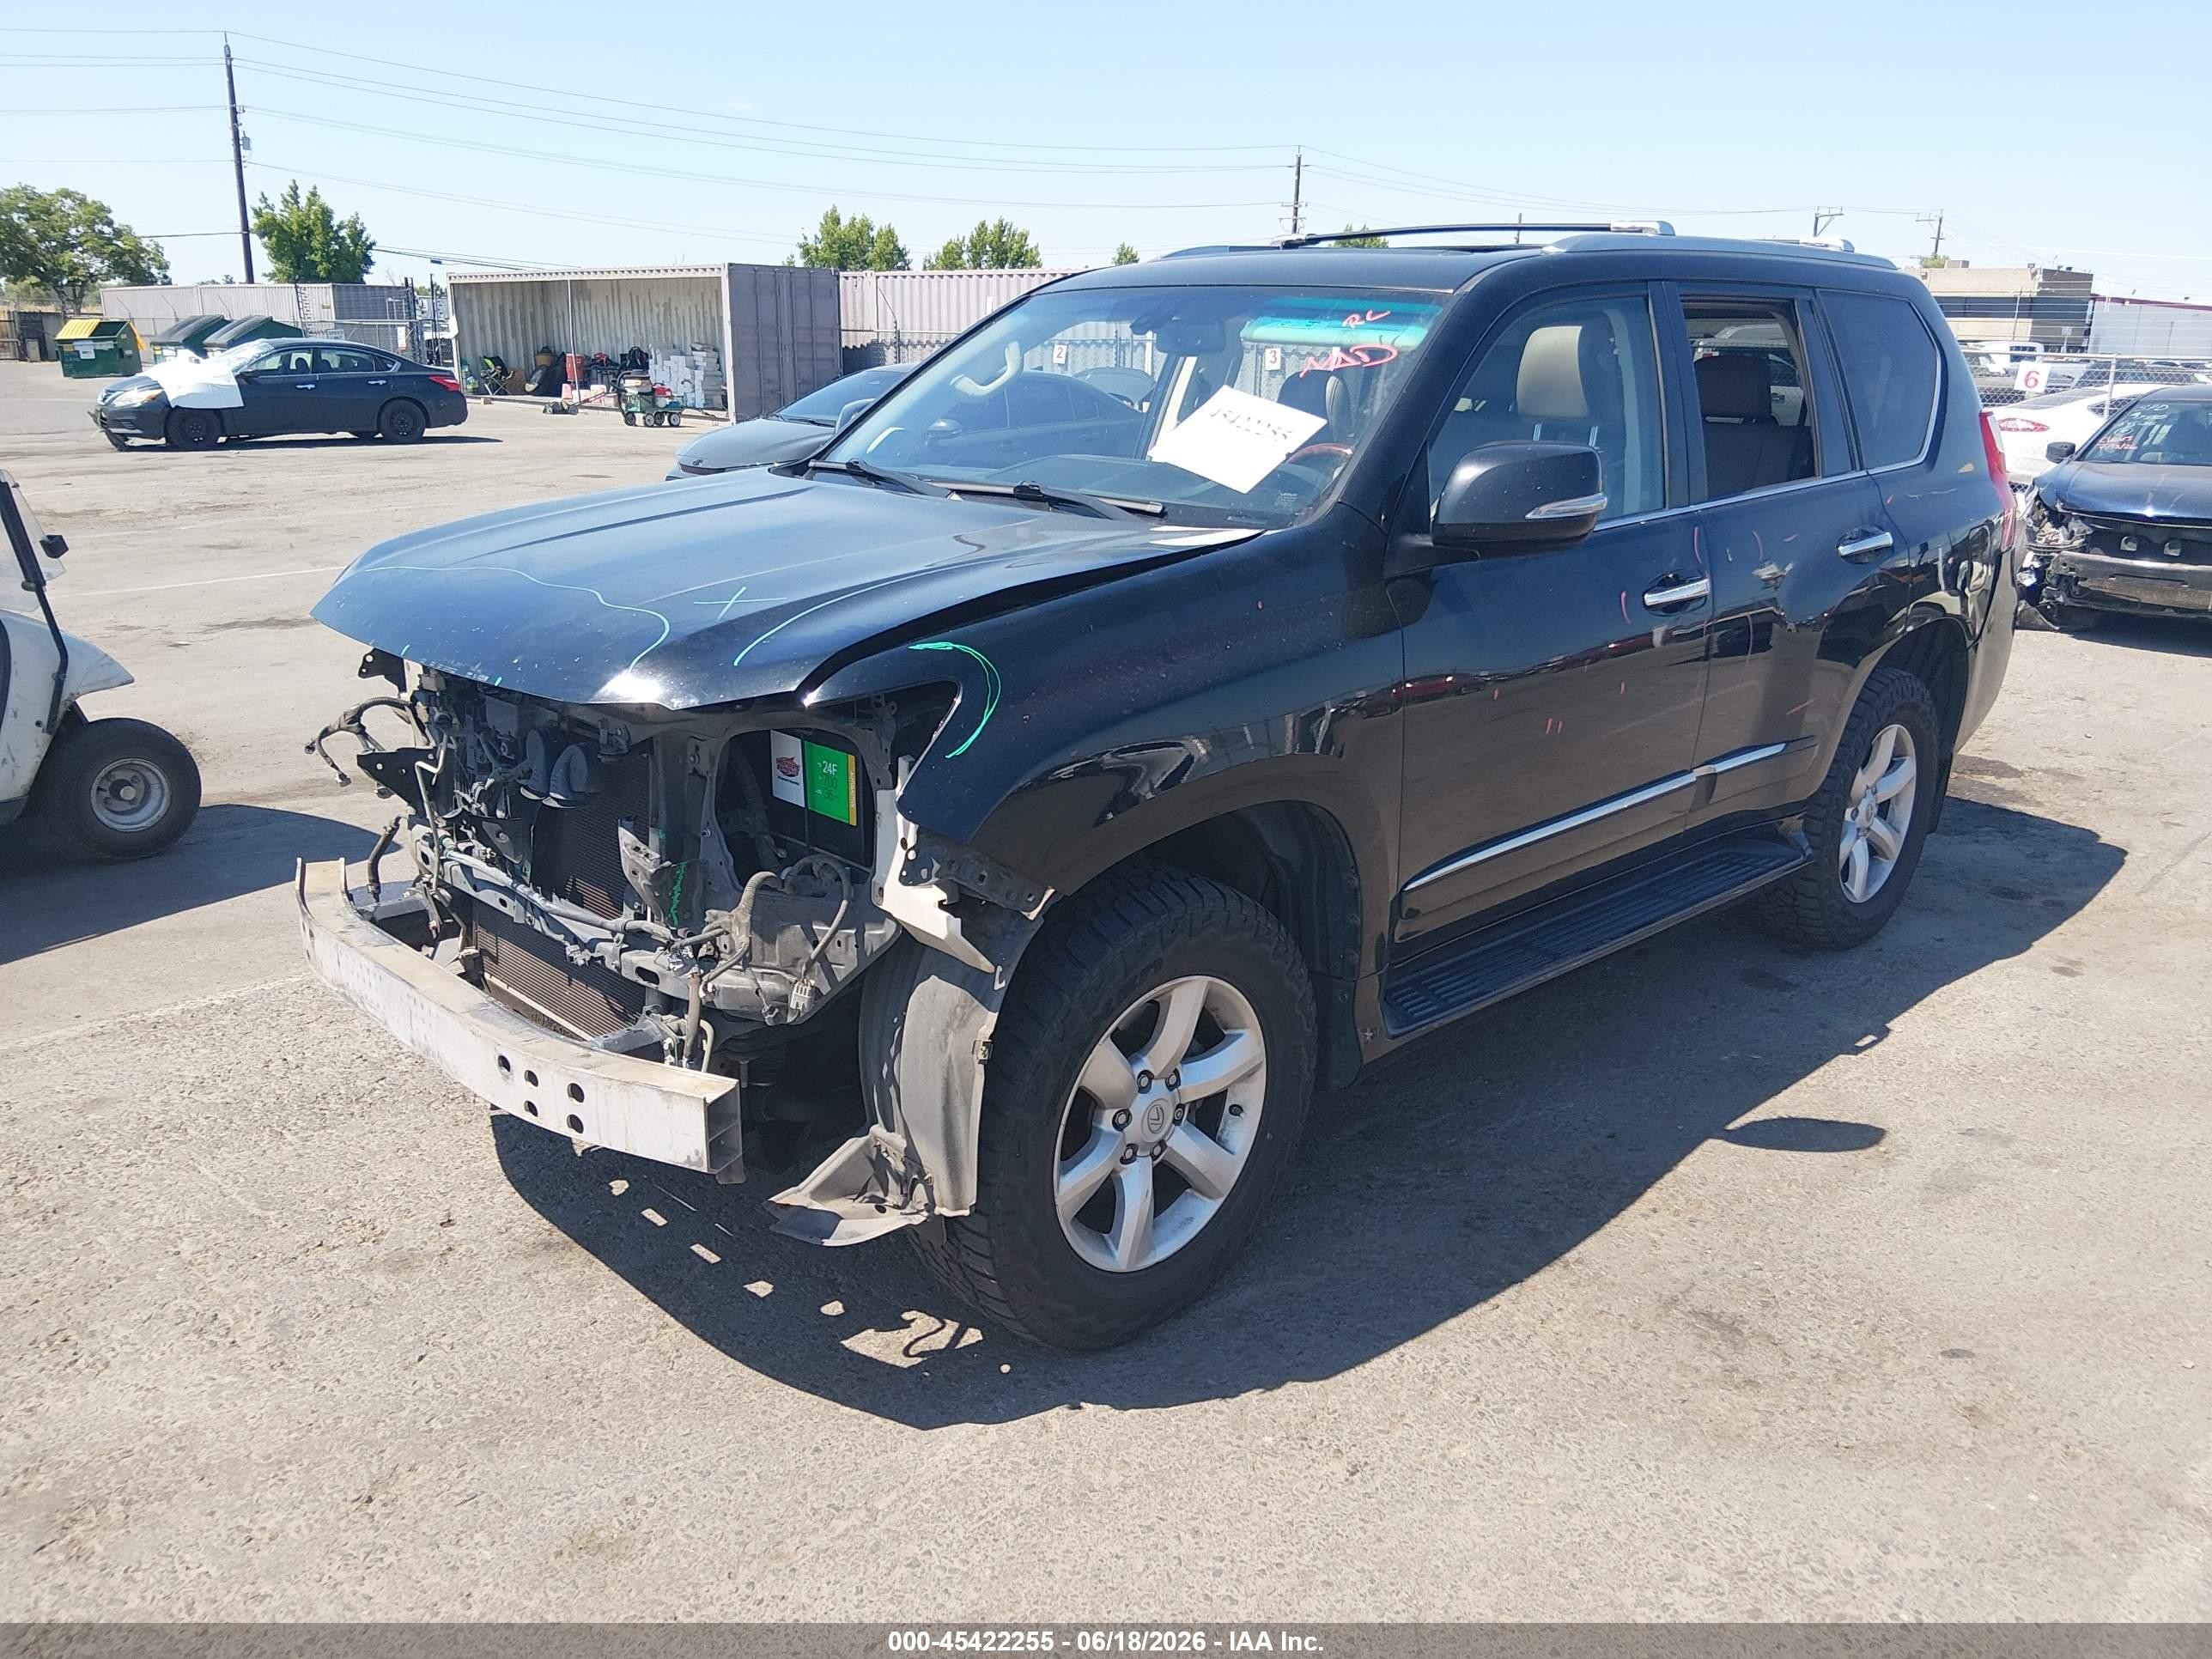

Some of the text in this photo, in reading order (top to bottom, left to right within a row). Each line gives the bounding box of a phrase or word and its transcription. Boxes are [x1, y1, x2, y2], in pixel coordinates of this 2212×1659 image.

[1056, 346, 1064, 359] 2
[1269, 349, 1278, 364] 3
[2024, 370, 2041, 388] 6
[823, 761, 838, 775] 24F
